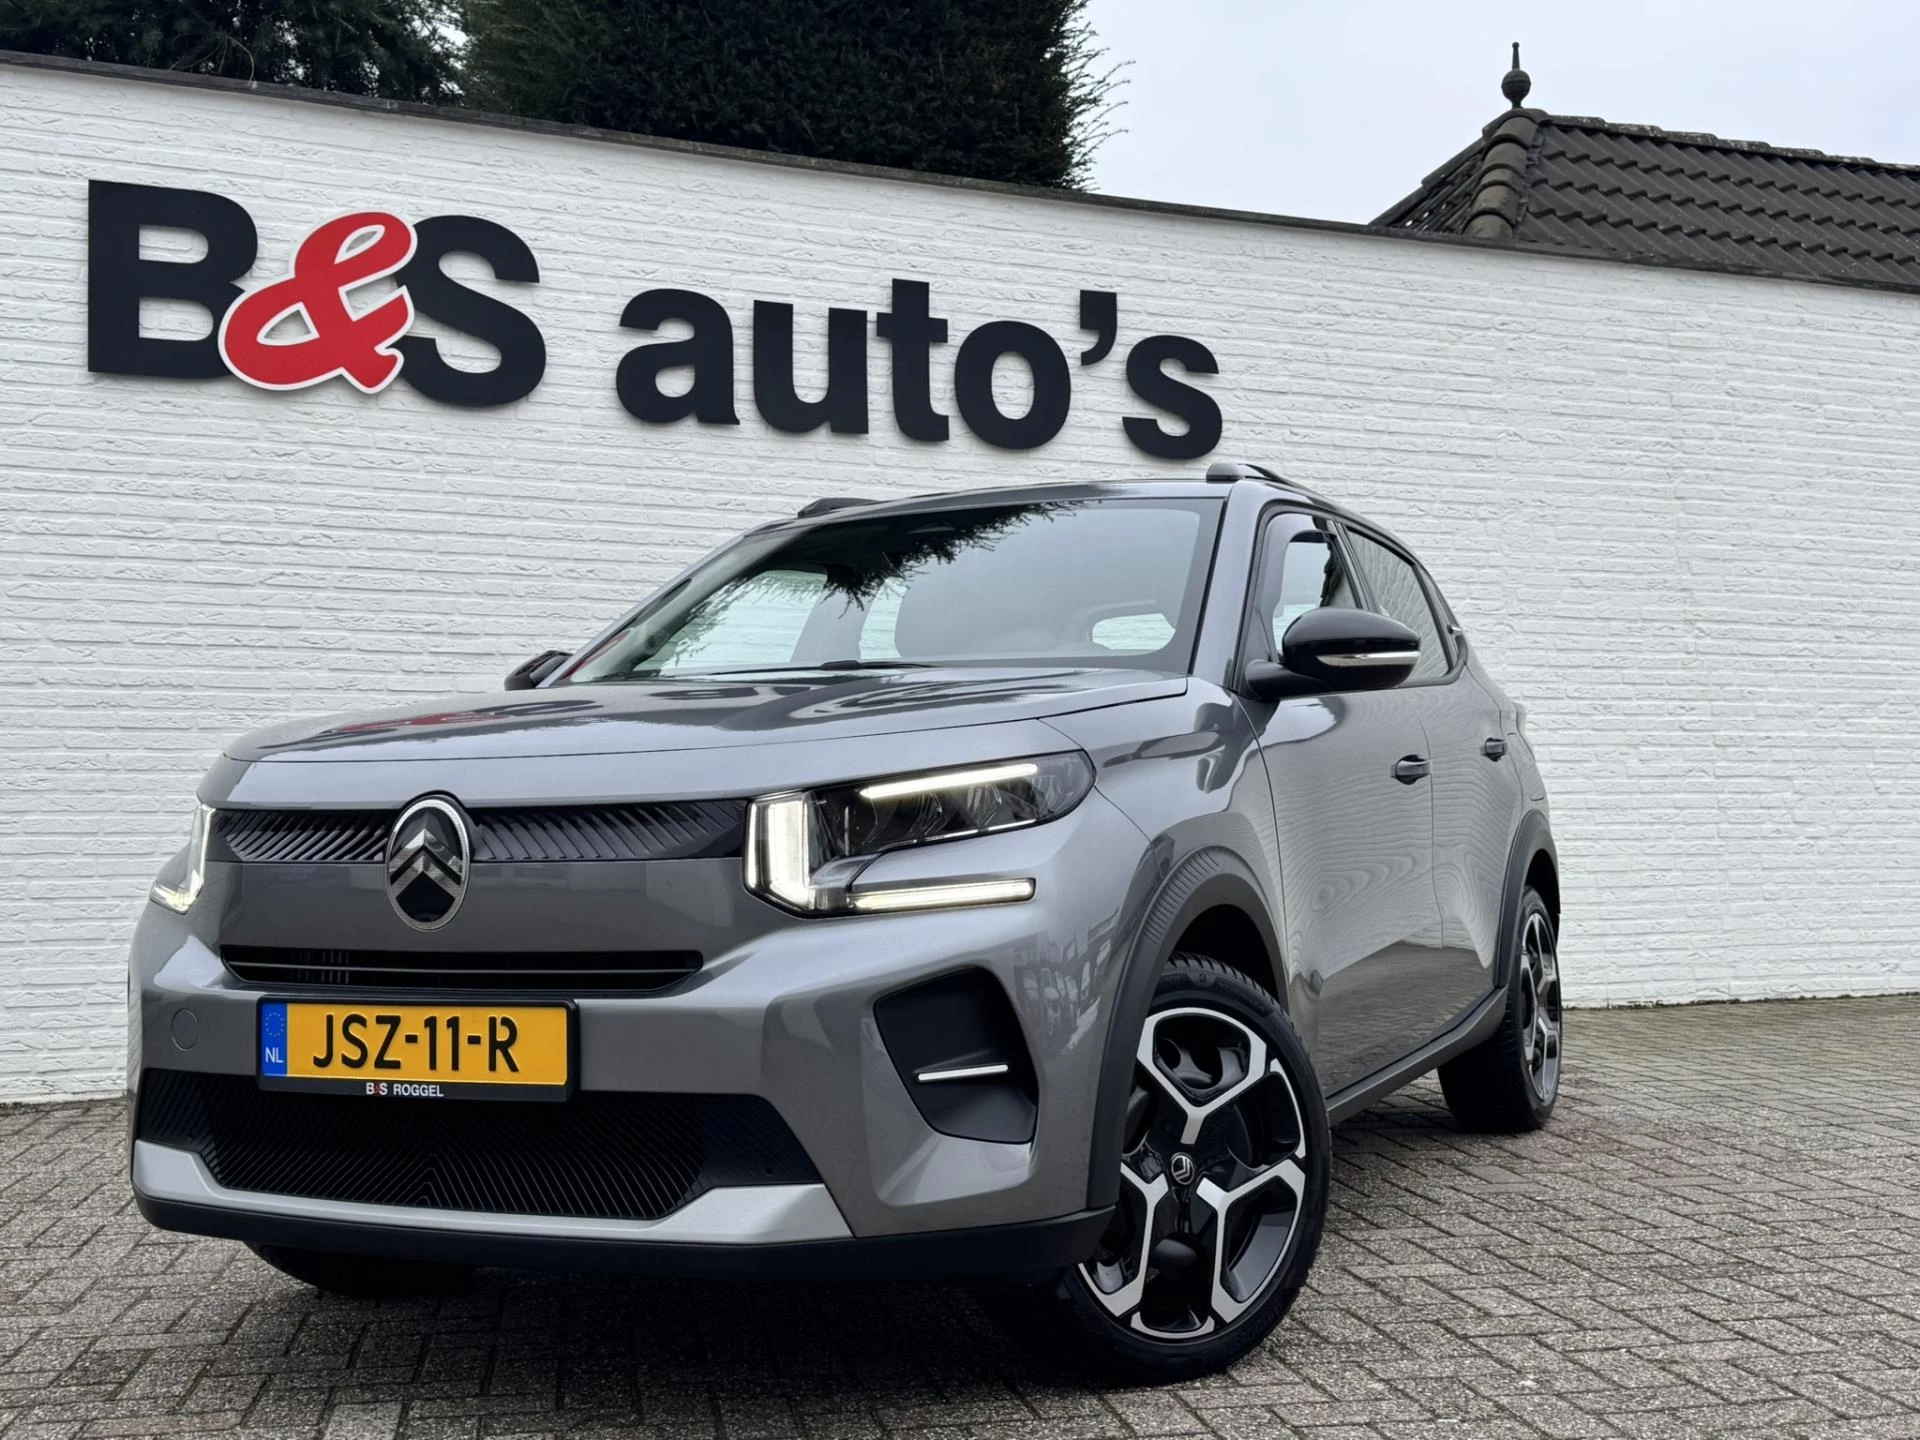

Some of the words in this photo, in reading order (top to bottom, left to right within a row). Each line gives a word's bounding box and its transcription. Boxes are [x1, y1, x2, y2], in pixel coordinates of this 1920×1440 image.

[88, 179, 546, 409] B&S
[616, 278, 1223, 459] auto's
[265, 1047, 284, 1064] NL
[313, 1013, 519, 1073] JSZ-11-R
[393, 1083, 445, 1098] ROGGEL
